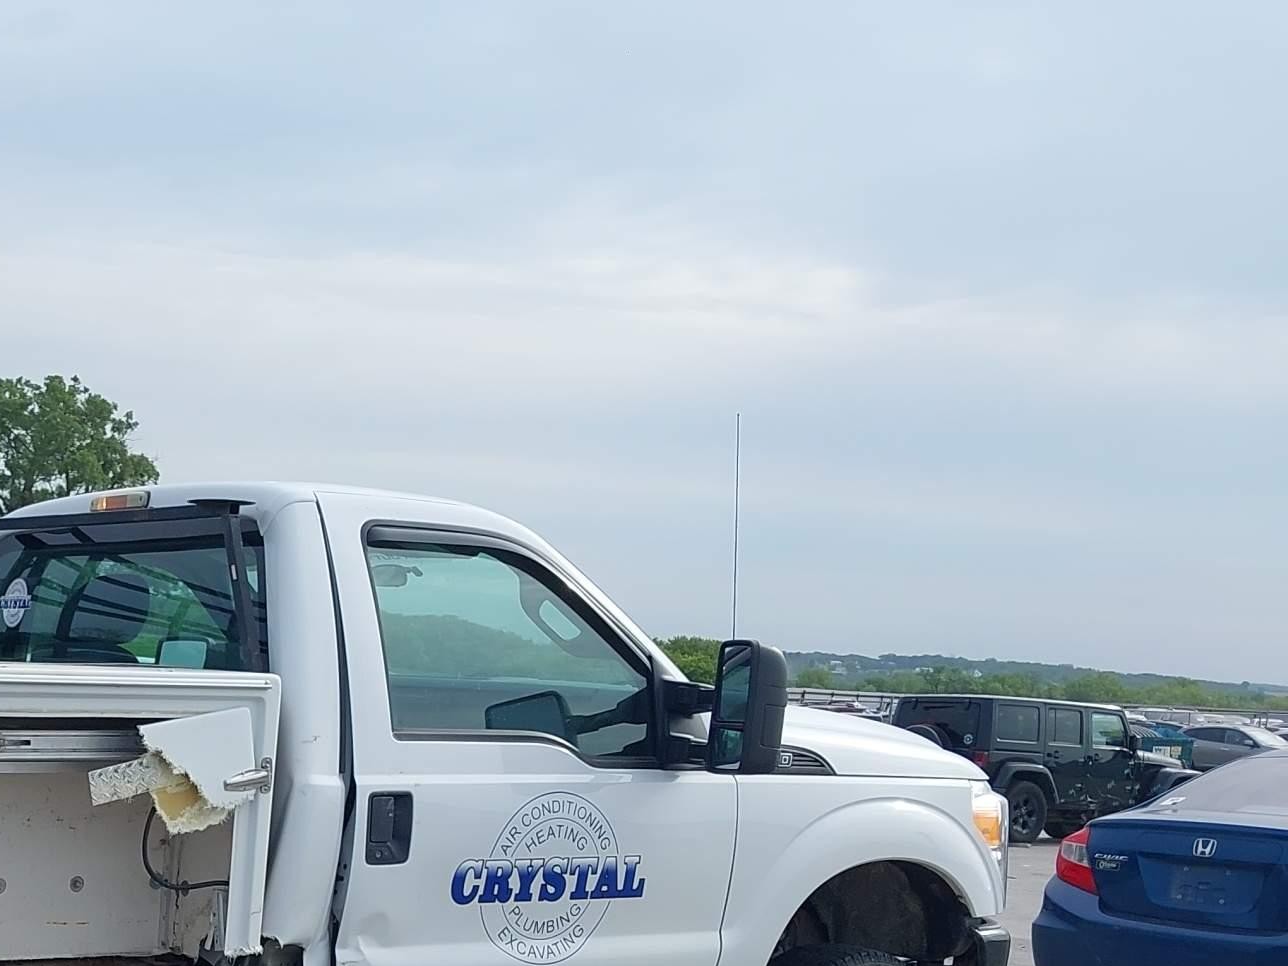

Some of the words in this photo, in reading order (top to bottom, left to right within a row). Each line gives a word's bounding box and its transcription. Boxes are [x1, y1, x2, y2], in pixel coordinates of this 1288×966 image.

[500, 826, 522, 856] AIR
[521, 800, 611, 851] CONDITIONING
[524, 825, 588, 853] HEATING
[451, 855, 646, 905] CRYSTAL
[508, 903, 581, 934] PLUMBING
[497, 924, 585, 959] EXCAVATING
